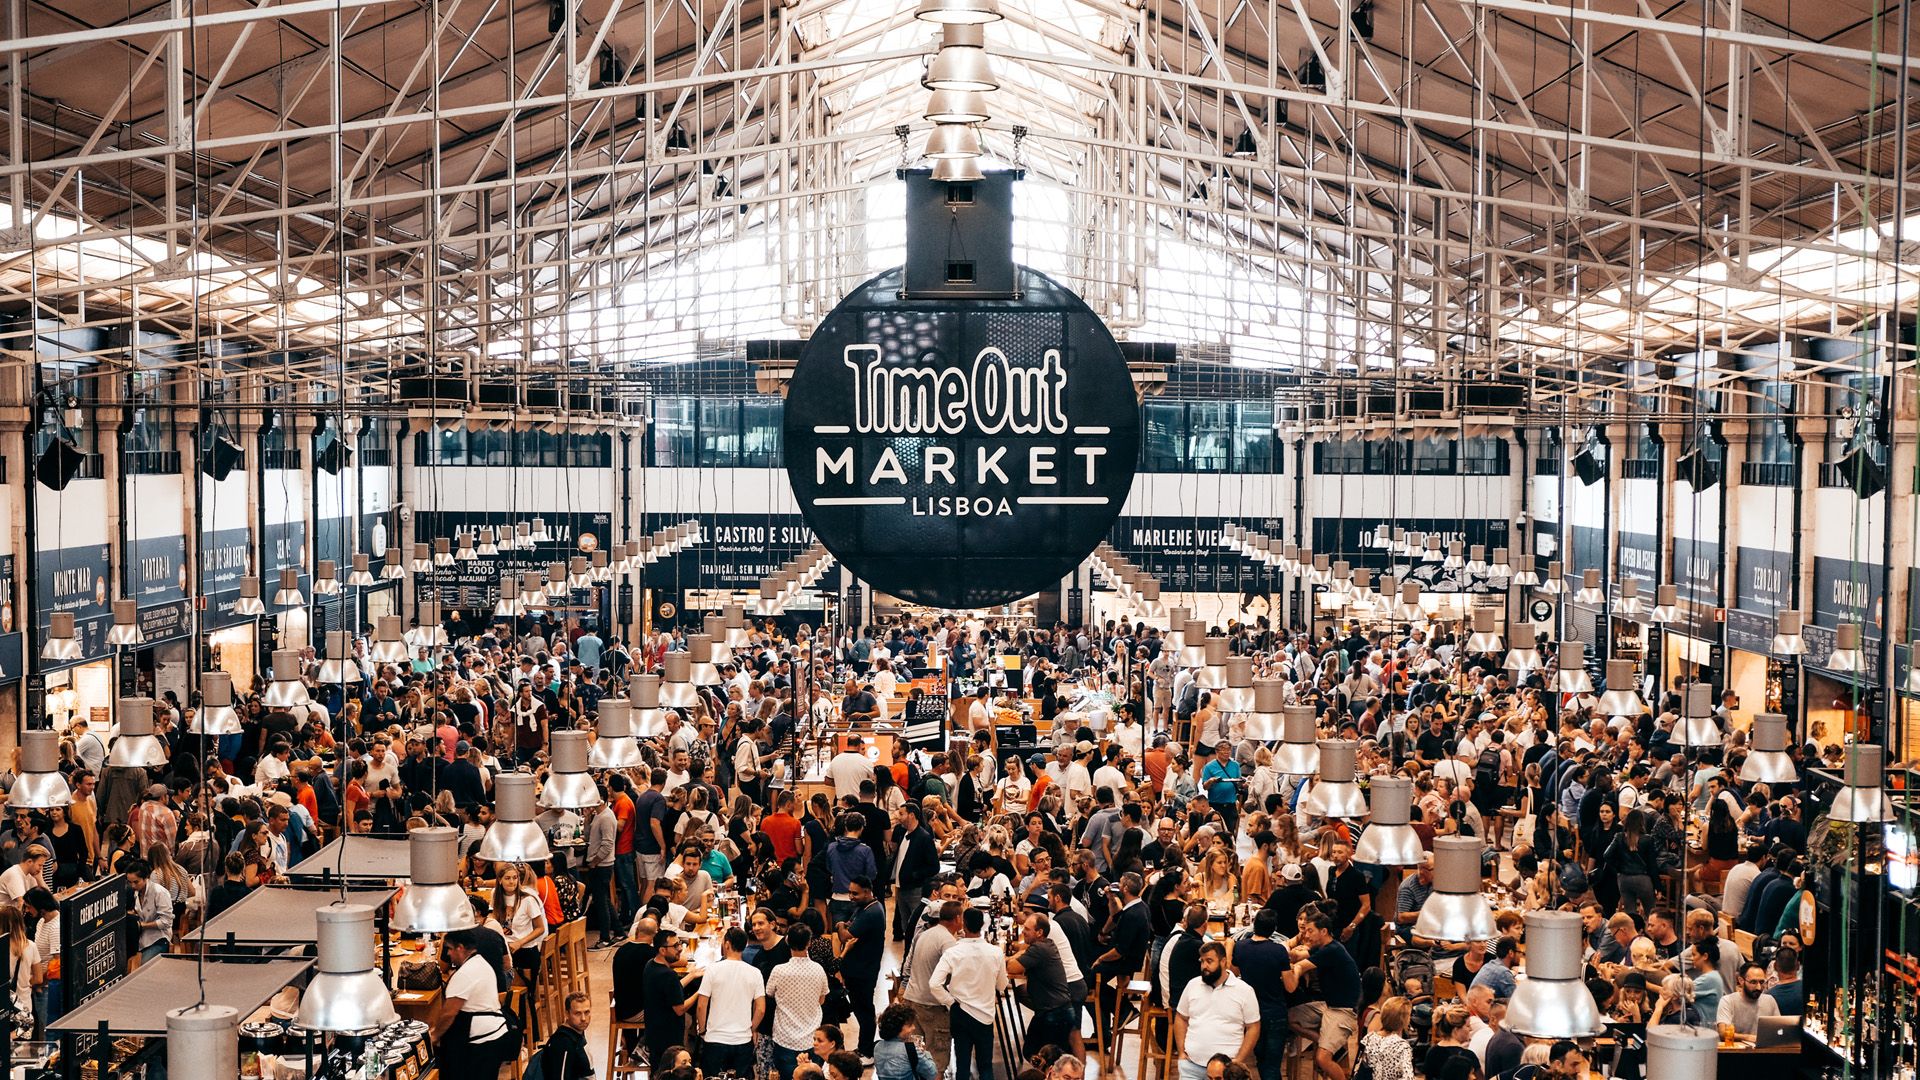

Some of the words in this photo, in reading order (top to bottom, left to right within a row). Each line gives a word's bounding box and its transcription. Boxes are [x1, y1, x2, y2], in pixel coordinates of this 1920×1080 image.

[844, 344, 968, 434] Time
[971, 346, 1068, 434] Out
[816, 446, 1107, 485] MARKET
[912, 496, 1014, 517] LISBOA
[454, 525, 530, 541] AEXANR
[716, 526, 764, 544] CASTRO
[770, 527, 776, 543] E
[1133, 529, 1193, 546] MARLENE
[1198, 529, 1223, 546] VIEI
[204, 549, 215, 571] CAF
[467, 566, 495, 575] FOOD
[739, 564, 753, 574] SEM
[1686, 555, 1700, 578] ASAN
[53, 569, 76, 597] MONTE
[77, 567, 91, 593] MAR
[1754, 566, 1767, 591] ZERO
[0, 577, 12, 606] DE
[94, 900, 100, 918] DE
[100, 897, 105, 915] LA
